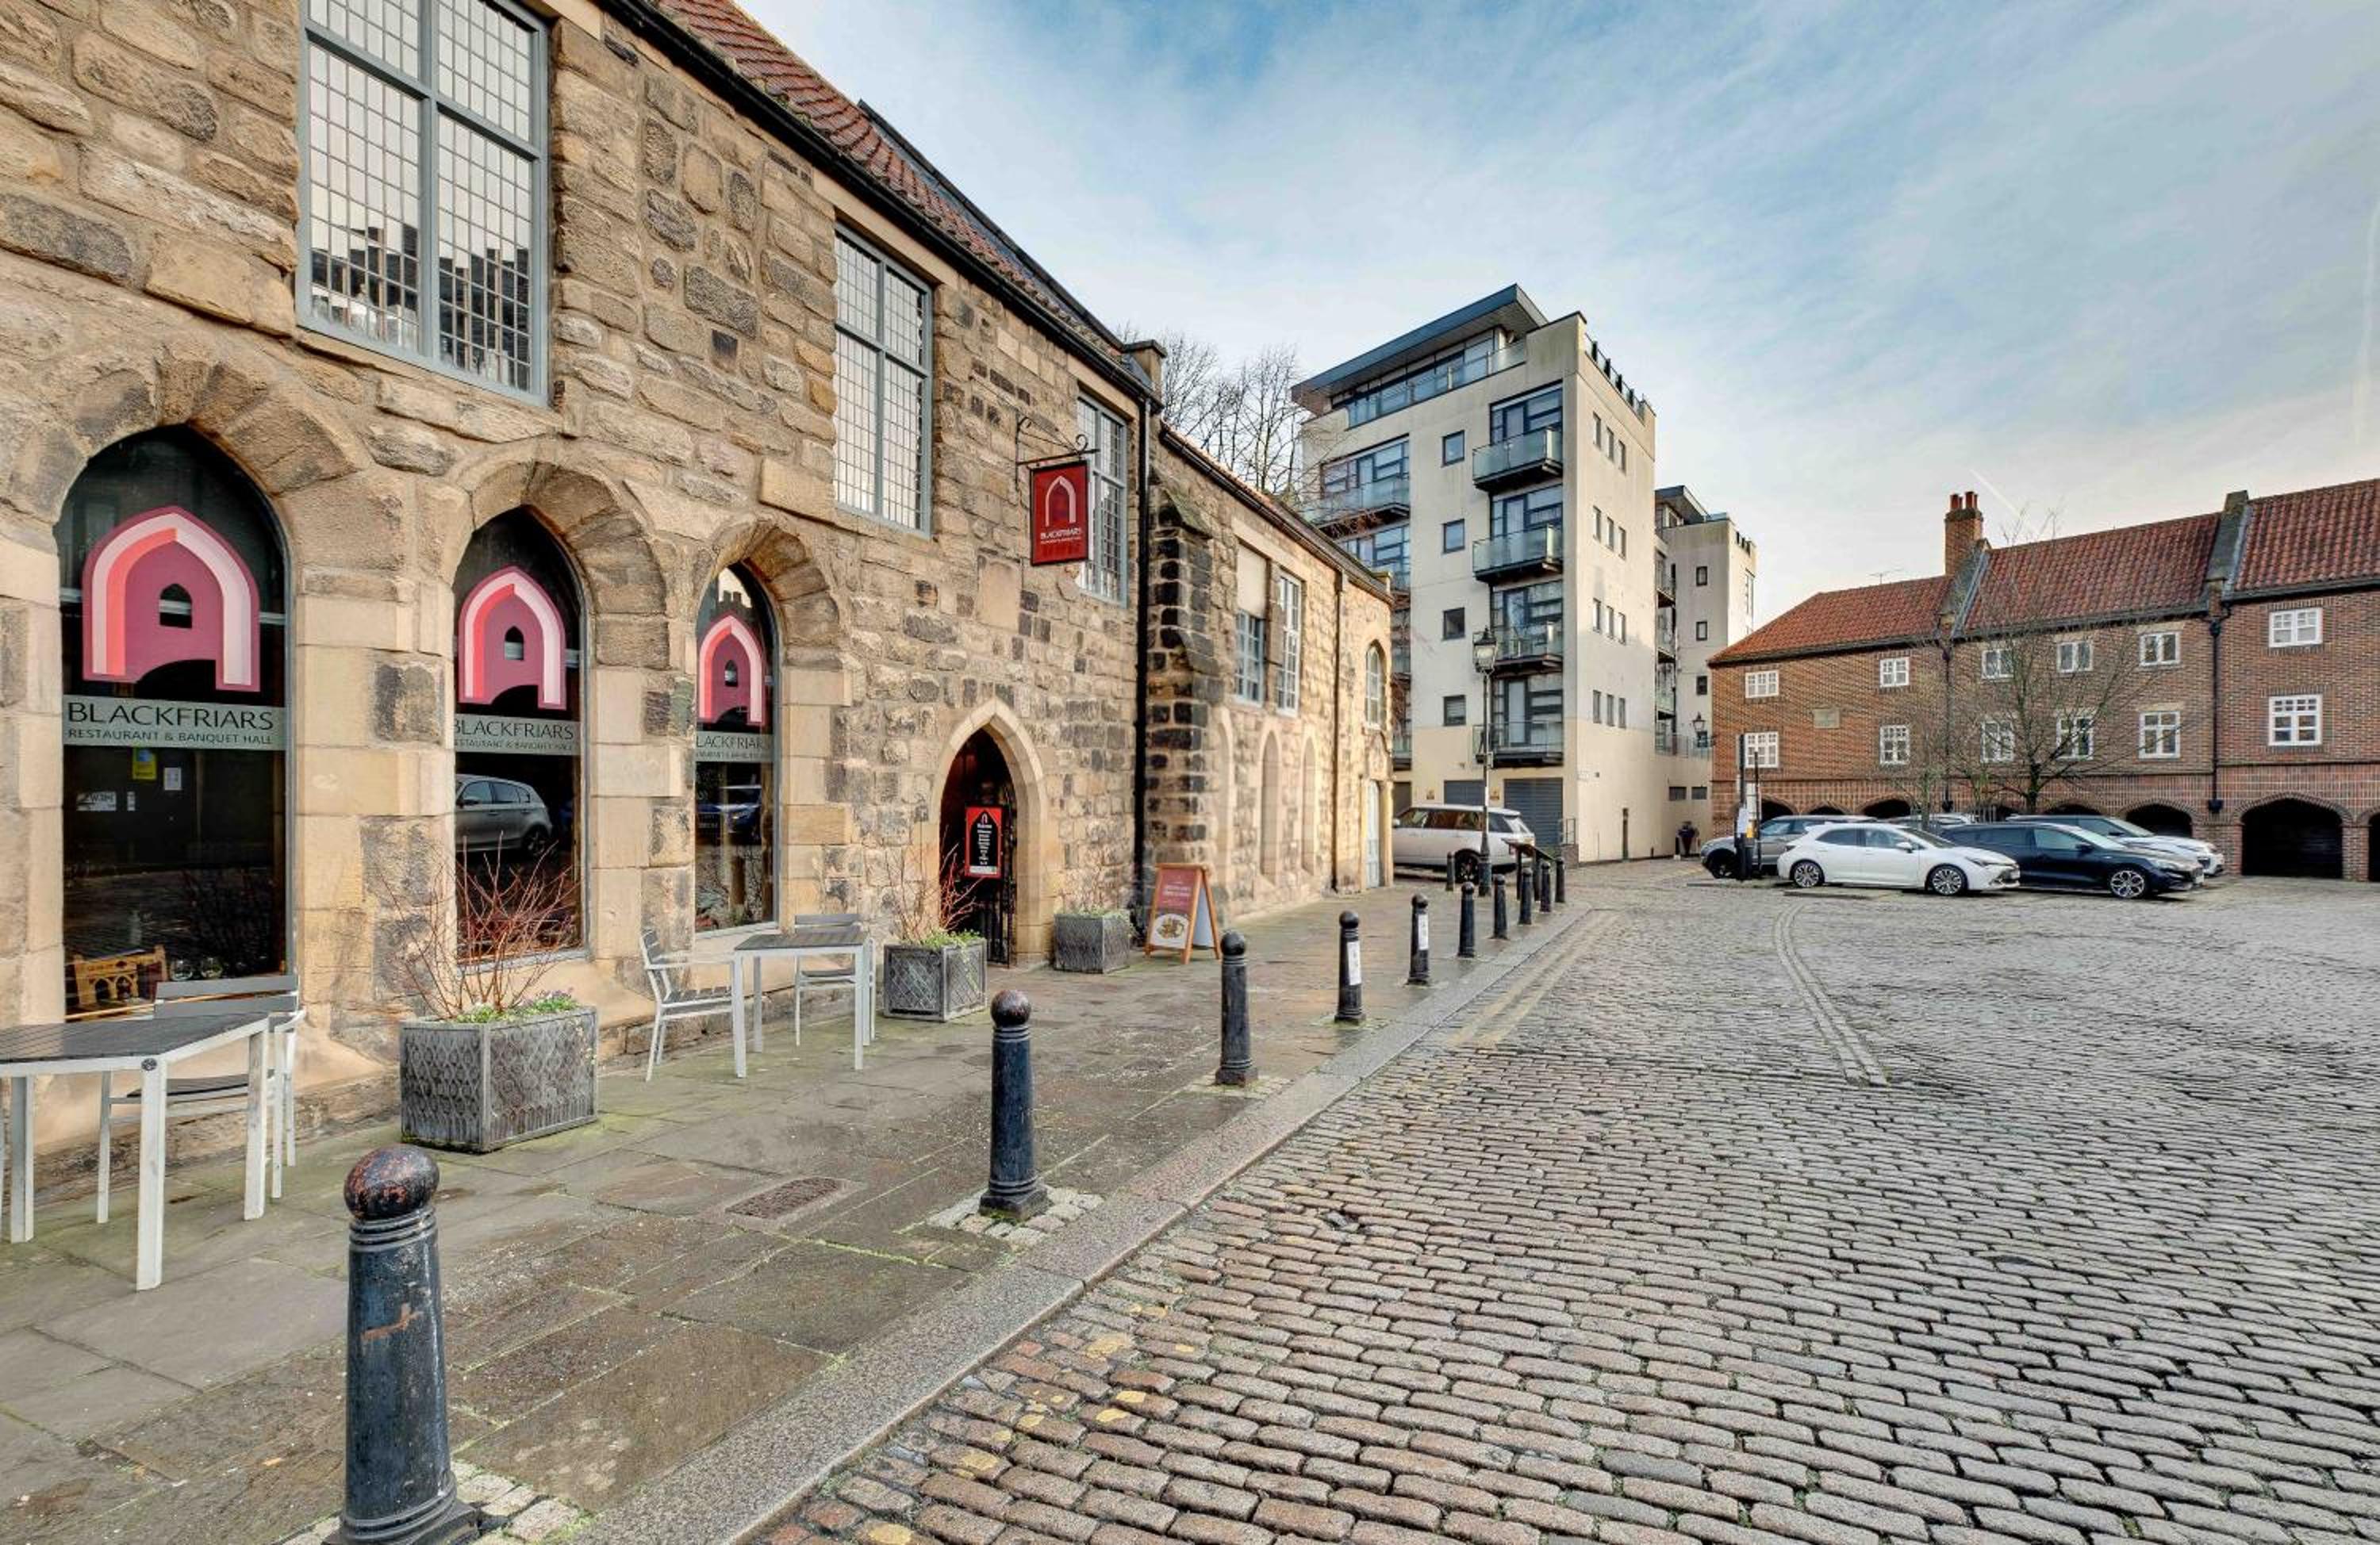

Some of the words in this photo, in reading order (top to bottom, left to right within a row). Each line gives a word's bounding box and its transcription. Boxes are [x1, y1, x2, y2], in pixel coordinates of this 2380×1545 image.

[67, 701, 274, 730] BLACKFRIARS
[68, 728, 159, 741] RESTAURANT
[164, 732, 175, 742] &
[178, 732, 239, 745] BANQUET
[243, 734, 273, 746] HALL
